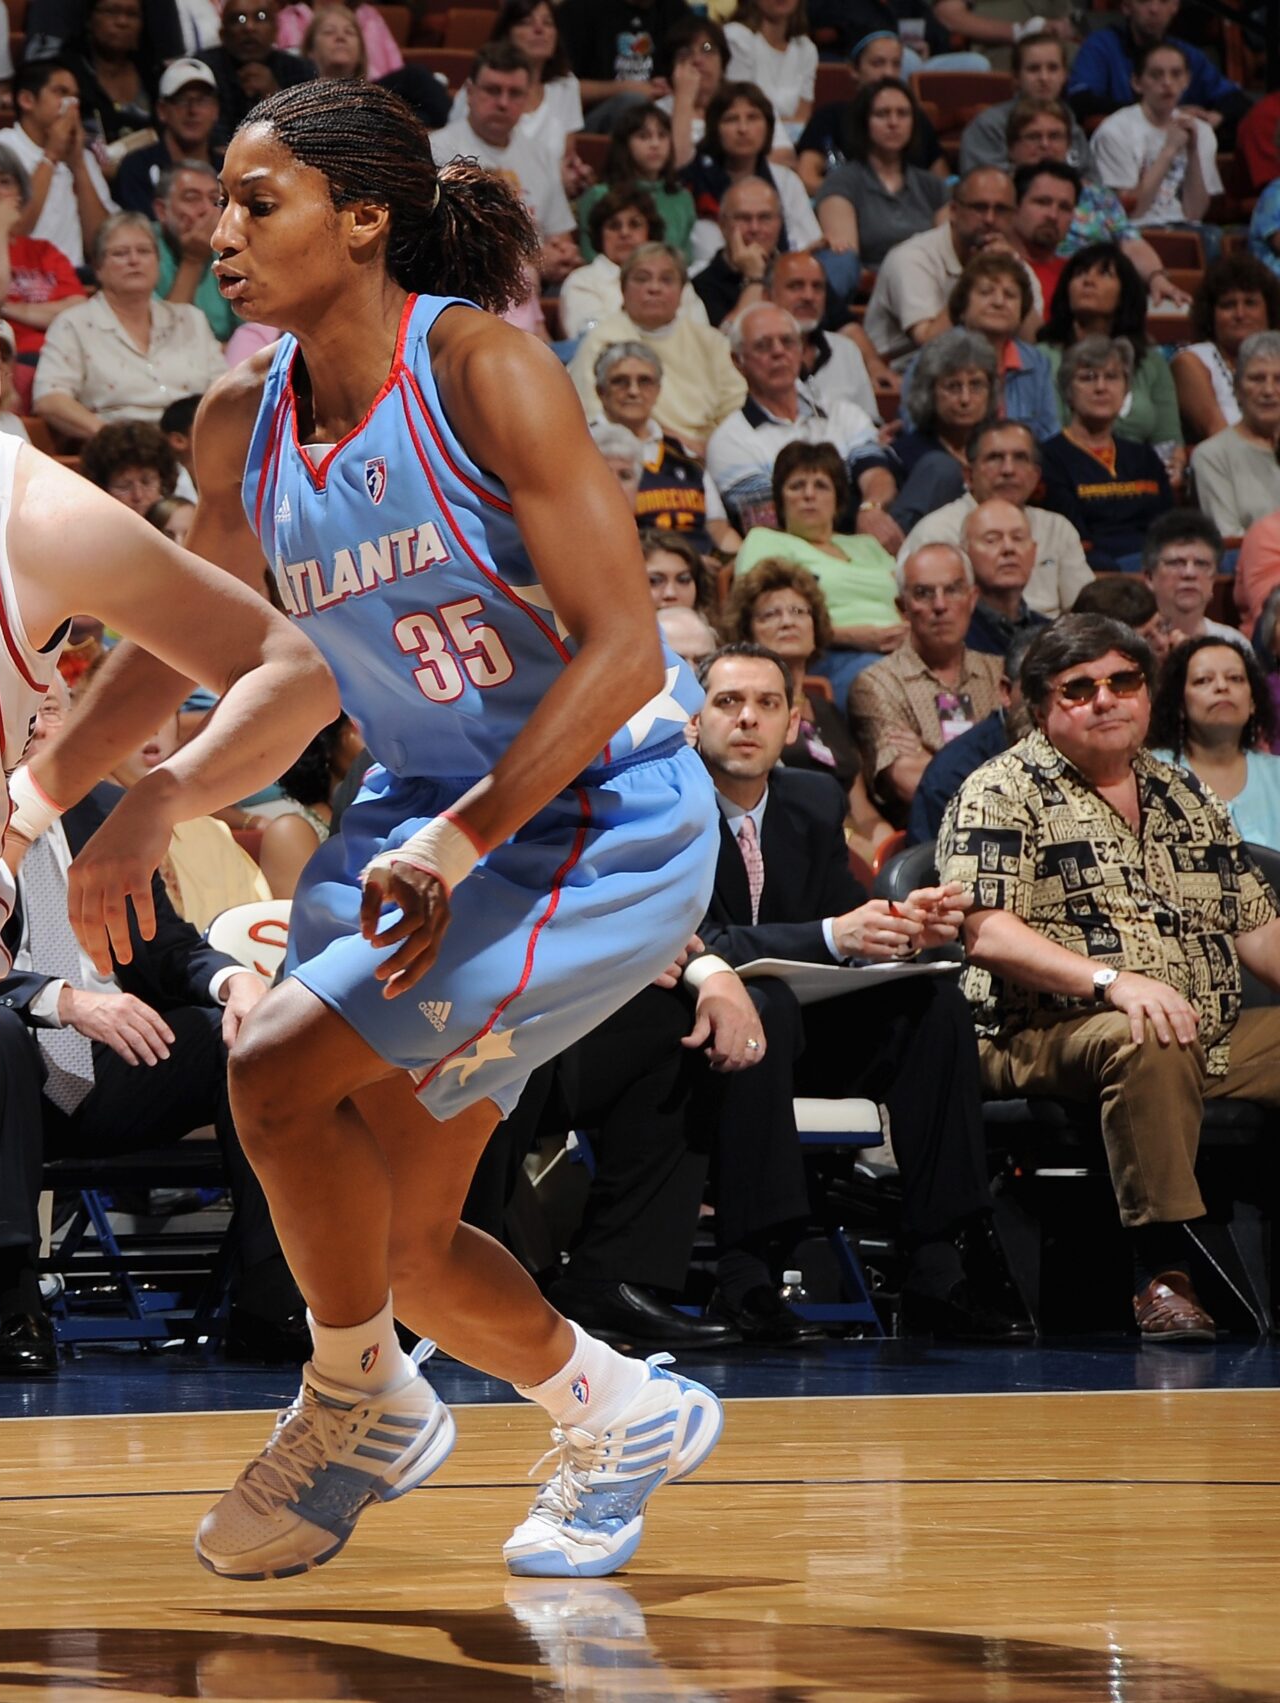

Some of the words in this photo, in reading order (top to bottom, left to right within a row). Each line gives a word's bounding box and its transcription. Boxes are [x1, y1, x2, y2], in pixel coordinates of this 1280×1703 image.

[276, 521, 451, 618] ATLANTA
[393, 594, 515, 703] 35
[418, 1001, 446, 1033] adidas
